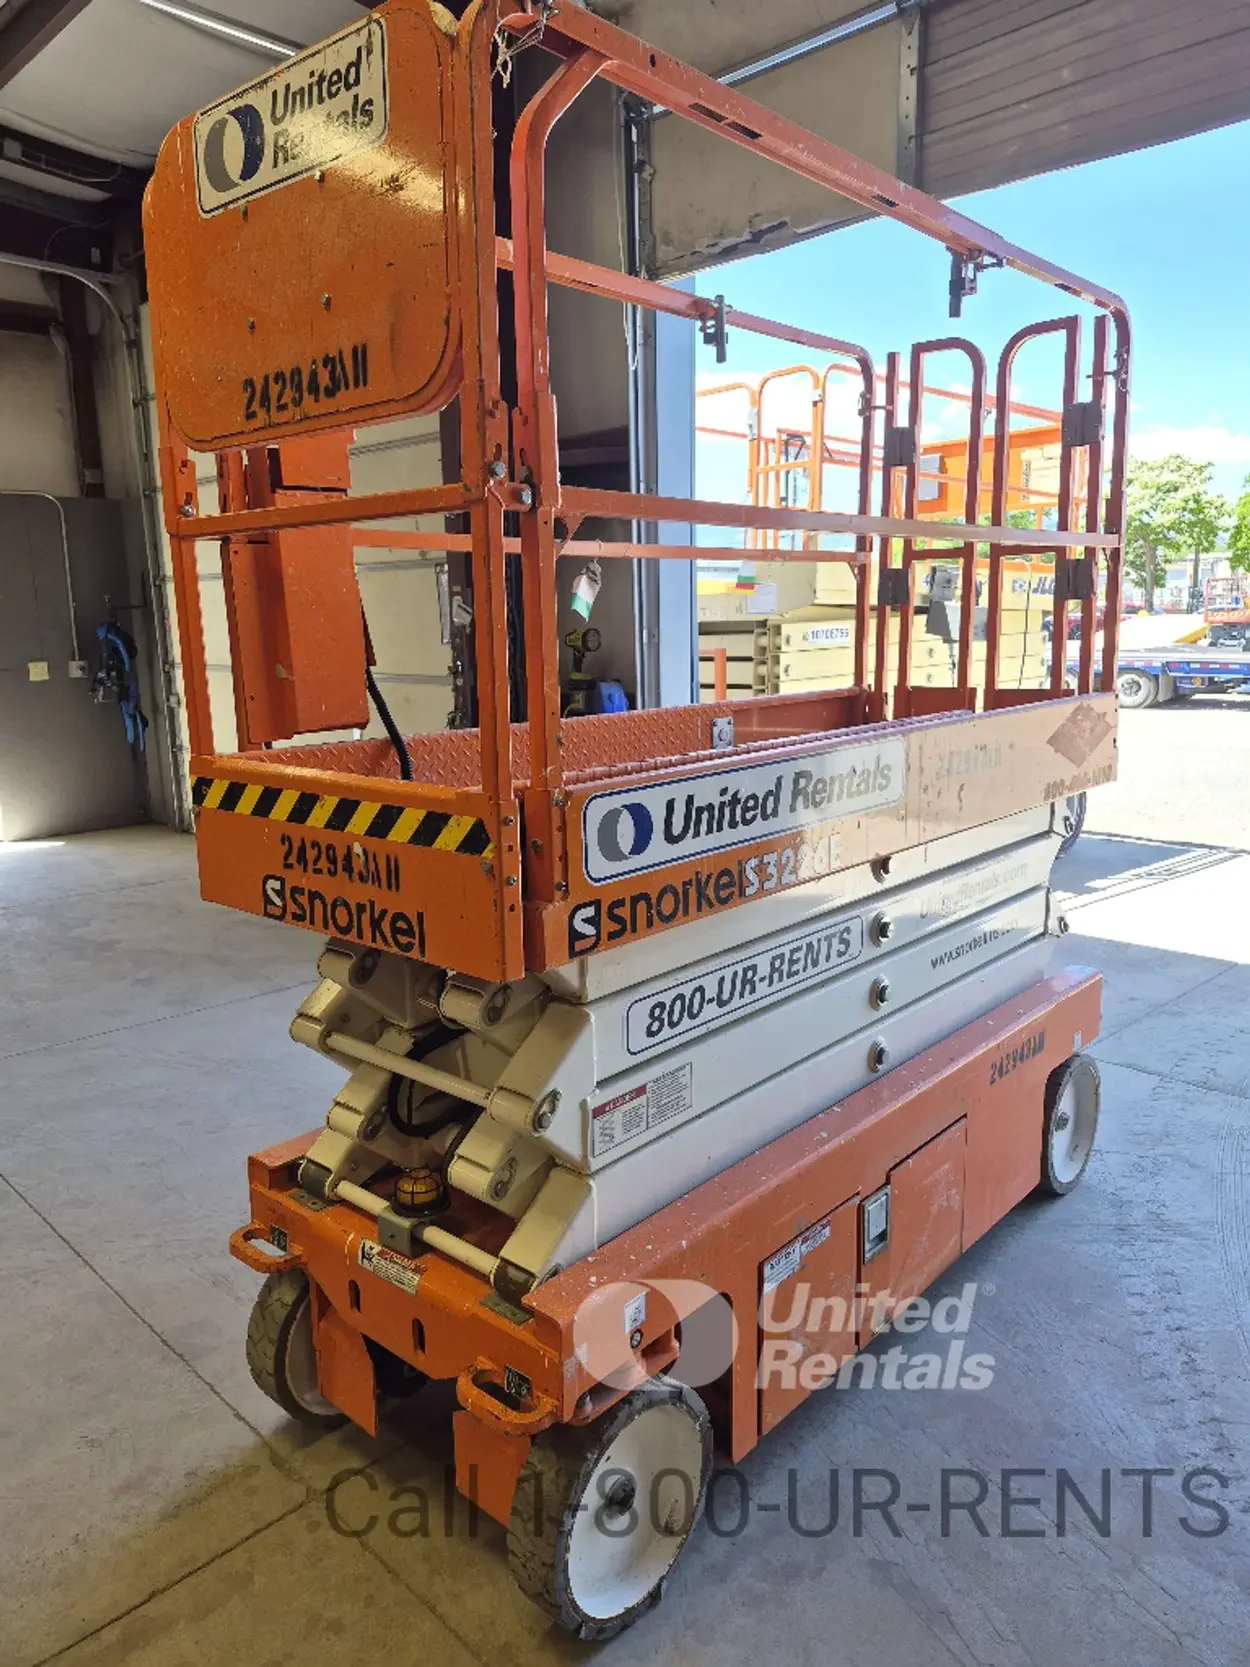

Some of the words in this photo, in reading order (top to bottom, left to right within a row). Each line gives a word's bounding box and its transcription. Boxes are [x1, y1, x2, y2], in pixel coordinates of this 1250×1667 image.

[270, 45, 363, 126] United
[664, 775, 783, 845] United
[790, 754, 893, 813] Rentals
[289, 884, 426, 957] snorkel
[607, 860, 745, 941] snorkel
[645, 926, 852, 1038] 800-UR-RENTS
